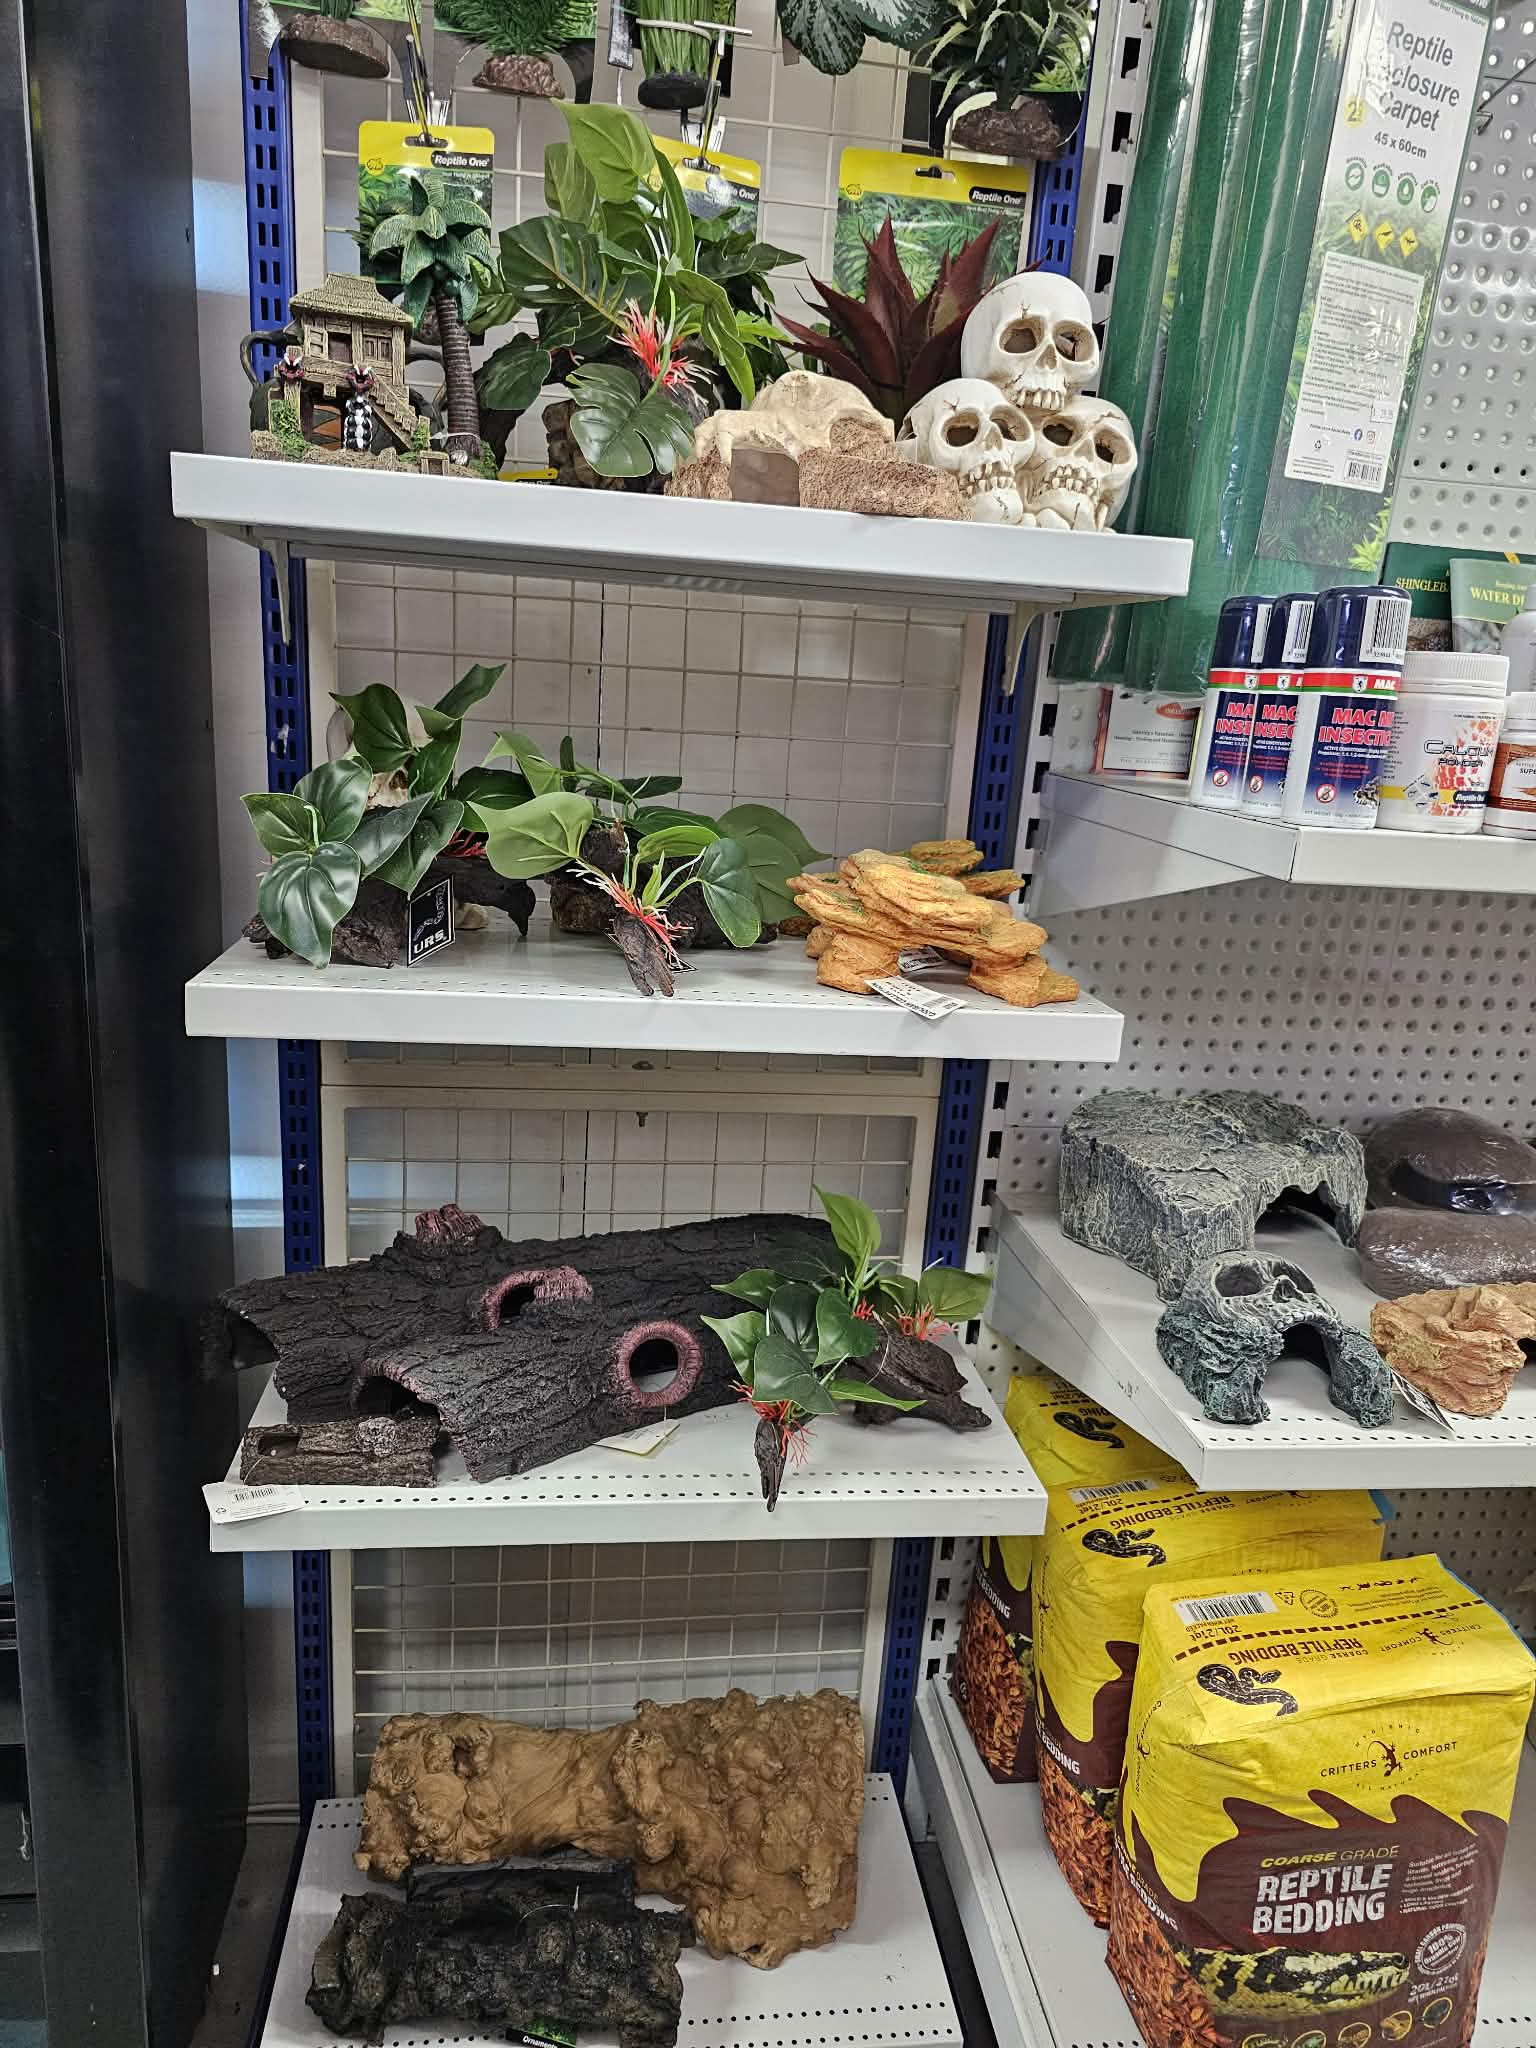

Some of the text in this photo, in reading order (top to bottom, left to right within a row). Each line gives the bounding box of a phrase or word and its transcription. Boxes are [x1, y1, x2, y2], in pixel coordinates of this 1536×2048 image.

[1387, 21, 1453, 66] Reptile
[1379, 91, 1440, 131] Carpet
[1374, 131, 1427, 159] 45 x 60cm
[434, 154, 489, 167] Reptile One
[738, 188, 757, 200] One
[971, 190, 1022, 205] Reptile One
[1470, 586, 1511, 605] WATER
[1374, 679, 1396, 690] MAC
[1331, 707, 1377, 726] MAC
[1438, 757, 1484, 767] POWDER
[413, 928, 446, 955] URS
[1110, 1495, 1232, 1529] REPTILE BEDDING
[1189, 1624, 1242, 1642] 20L/21qt
[1438, 1623, 1483, 1636] CRITTERS
[1228, 1637, 1364, 1666] REPTILE BEDDING
[1329, 1649, 1369, 1659] COARSE
[1380, 1636, 1423, 1652] COMFORT
[1042, 1731, 1081, 1775] BEDDING
[1320, 1741, 1458, 1777] CRITTERS COMFORT
[1260, 1844, 1401, 1868] COARSE GRADE
[1256, 1863, 1393, 1903] REPTILE
[1252, 1891, 1387, 1935] BEDDING
[1427, 1934, 1454, 1955] 100%
